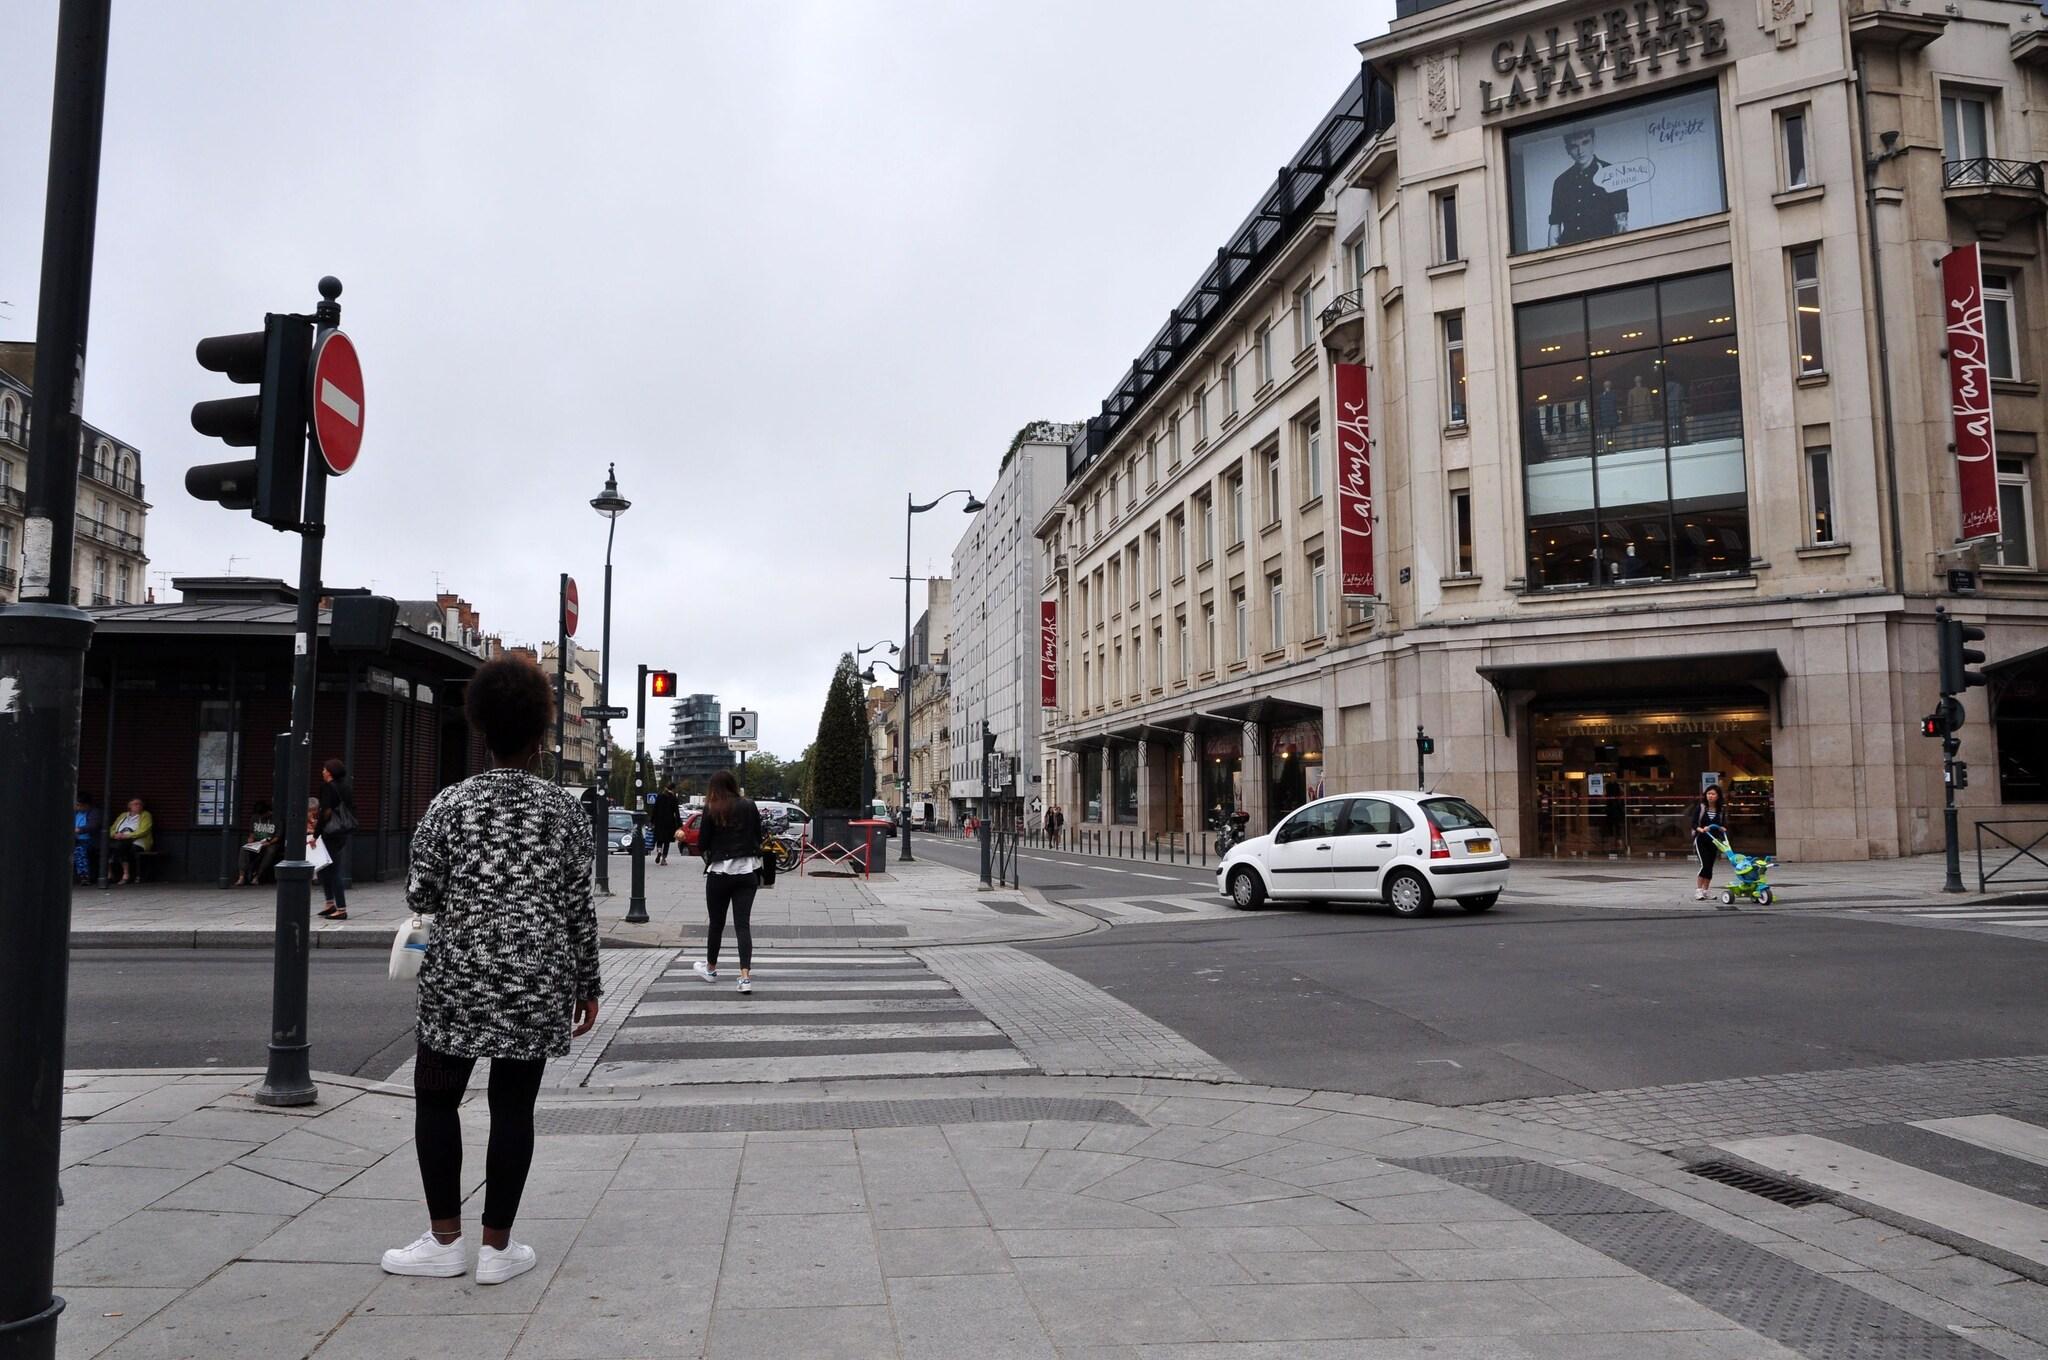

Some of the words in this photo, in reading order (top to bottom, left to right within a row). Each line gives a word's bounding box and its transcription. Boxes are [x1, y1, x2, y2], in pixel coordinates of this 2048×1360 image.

[1492, 0, 1709, 73] GALERIES
[1480, 19, 1728, 114] LAFAYETTE
[731, 715, 746, 736] P
[1567, 723, 1639, 737] GALERIES
[1656, 718, 1741, 734] LAFAYETTE
